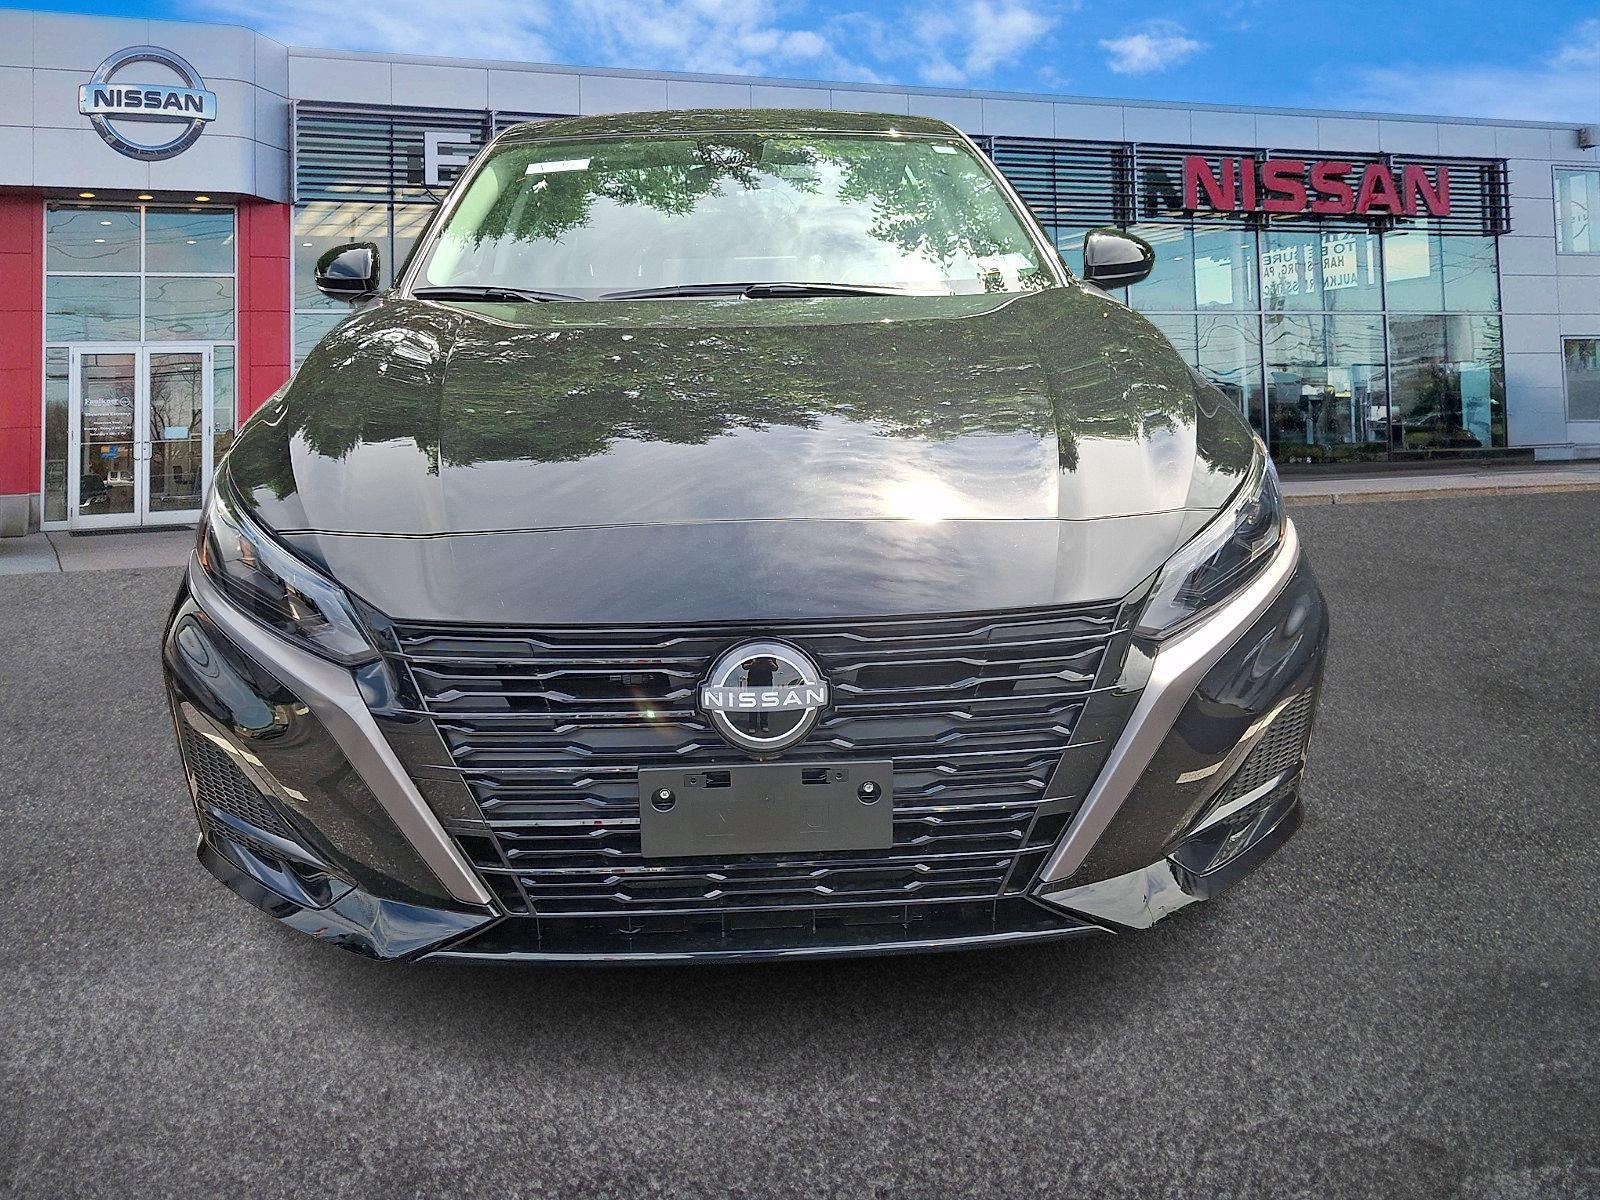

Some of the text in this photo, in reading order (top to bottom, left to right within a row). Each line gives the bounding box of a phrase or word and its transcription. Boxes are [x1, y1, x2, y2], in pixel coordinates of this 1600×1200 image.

[94, 90, 203, 113] NISSAN
[1183, 155, 1450, 217] NISSAN
[704, 687, 824, 708] NISSAN
